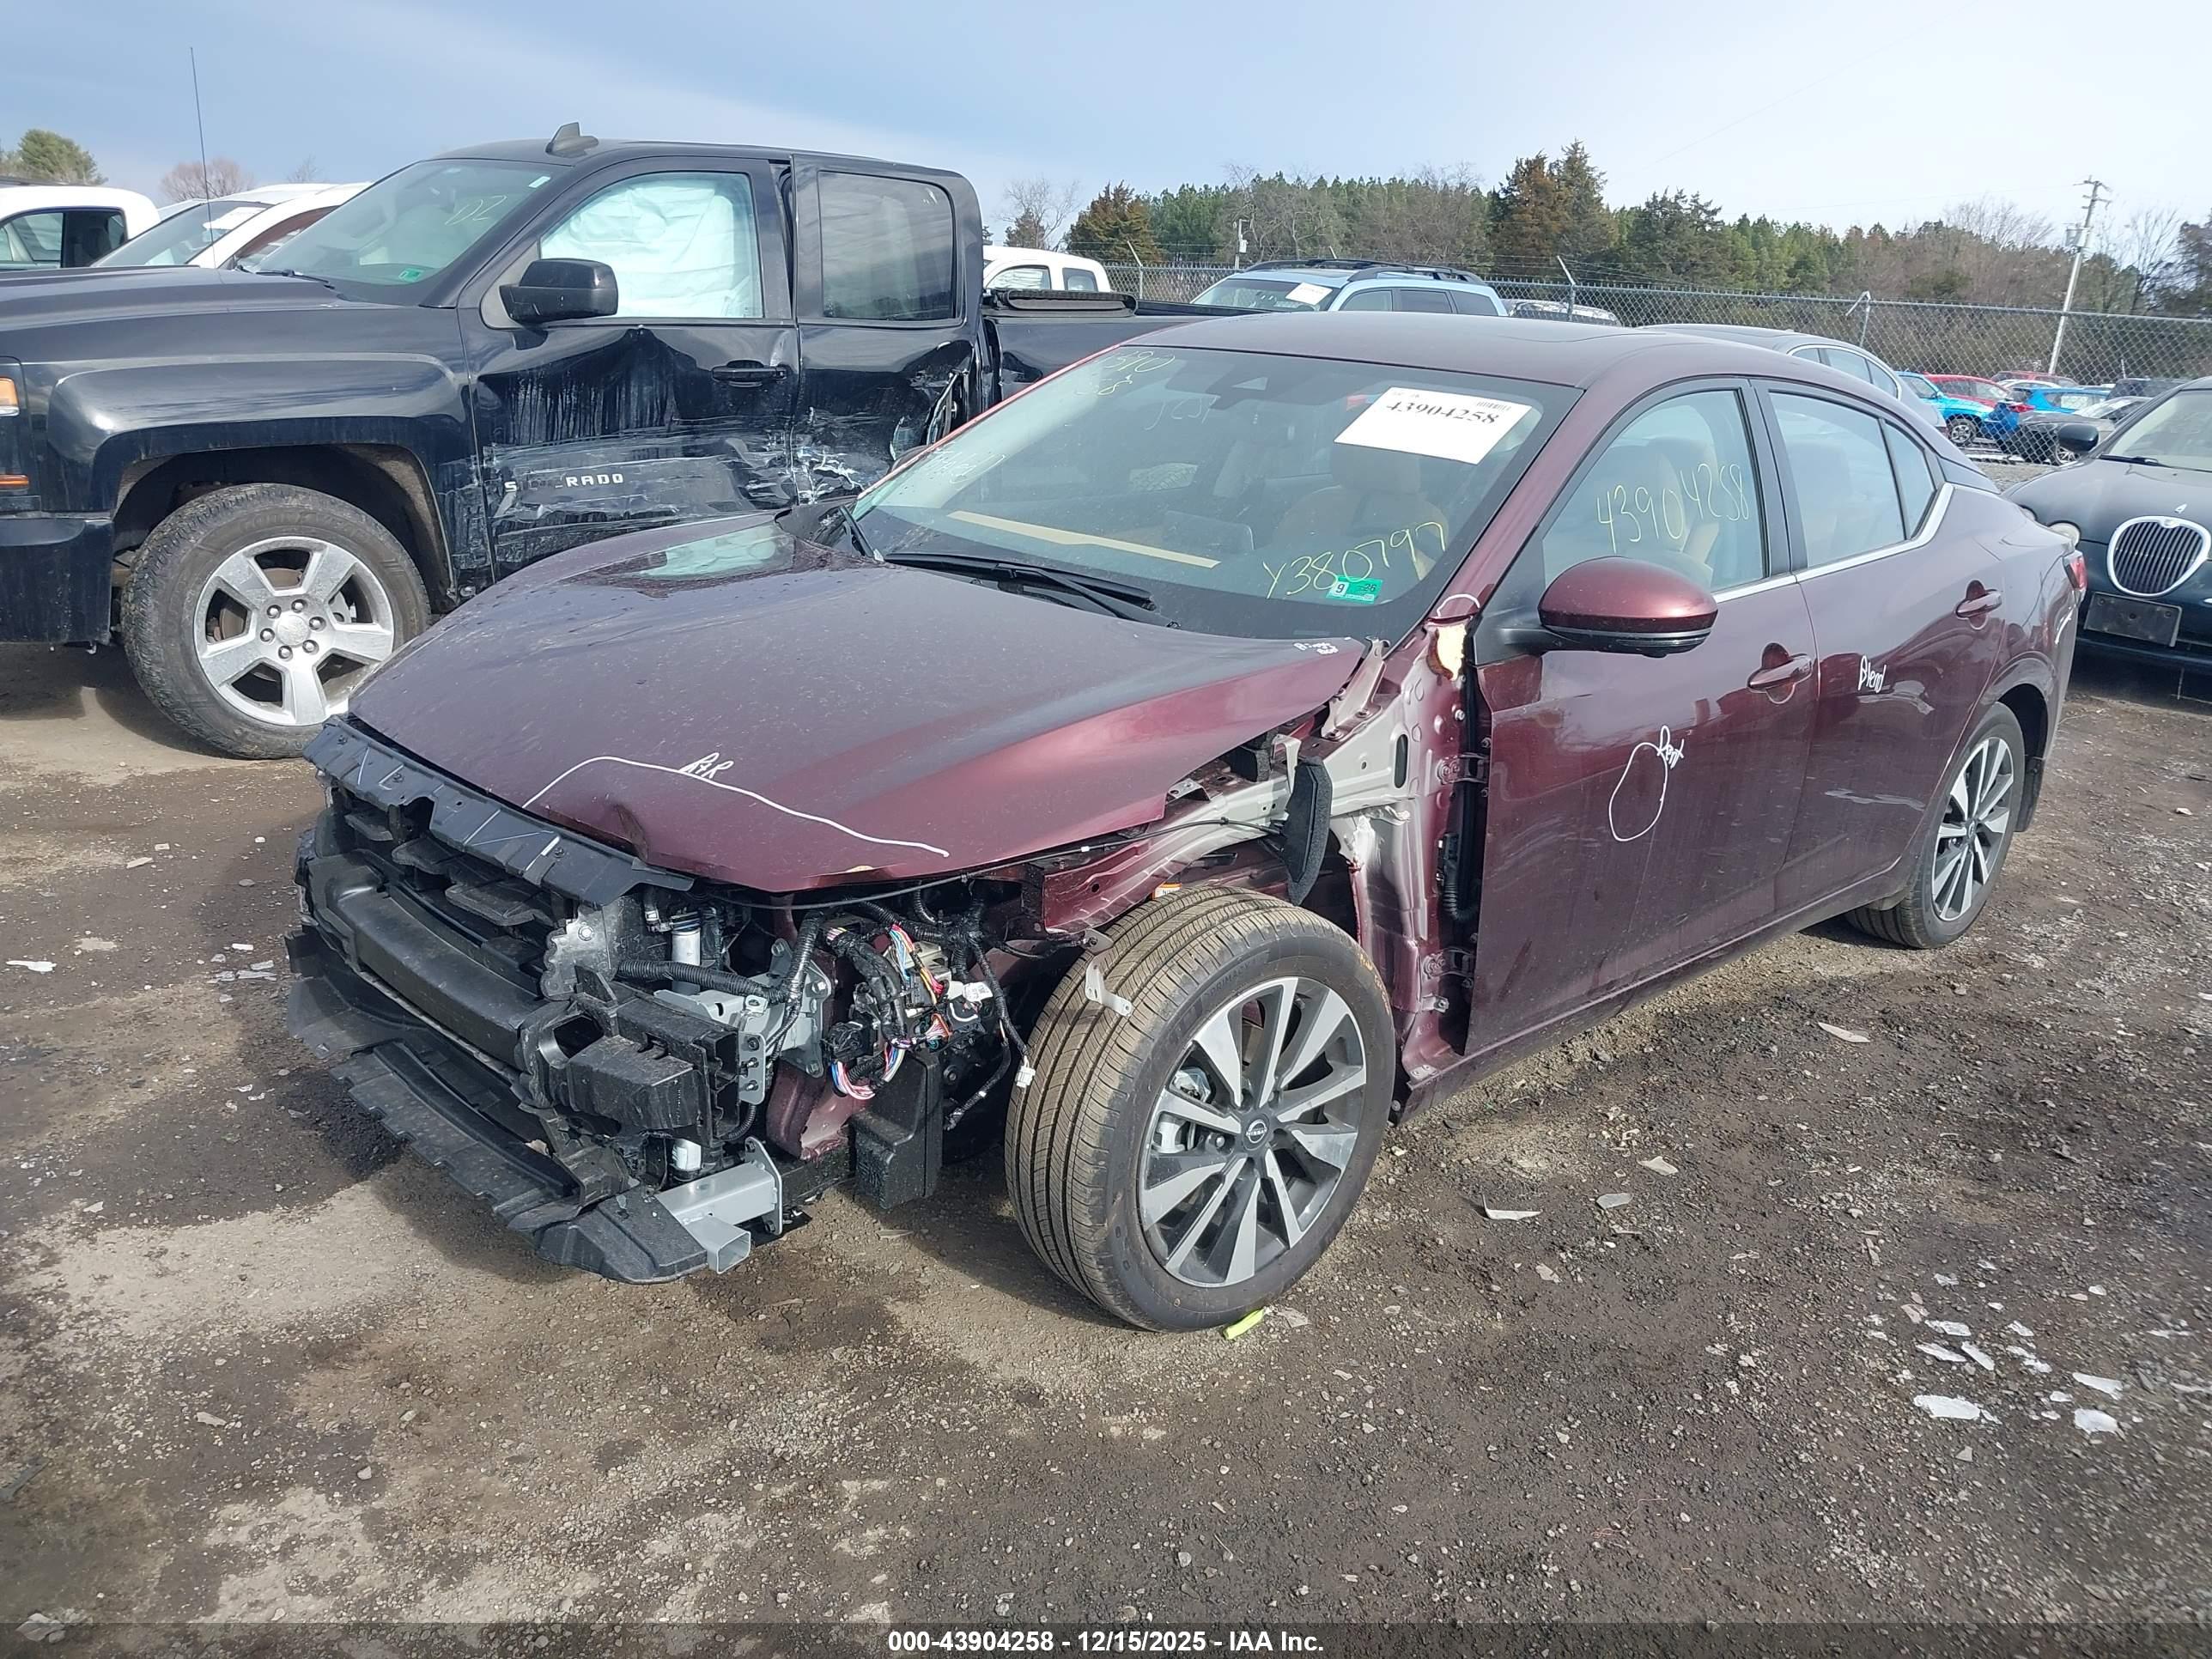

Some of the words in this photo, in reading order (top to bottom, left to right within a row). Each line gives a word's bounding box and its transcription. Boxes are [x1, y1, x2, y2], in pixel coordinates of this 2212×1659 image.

[1386, 400, 1500, 424] 43904258
[1595, 463, 1749, 554] 43904258
[1262, 522, 1446, 599] Y380797
[1336, 583, 1346, 593] 9
